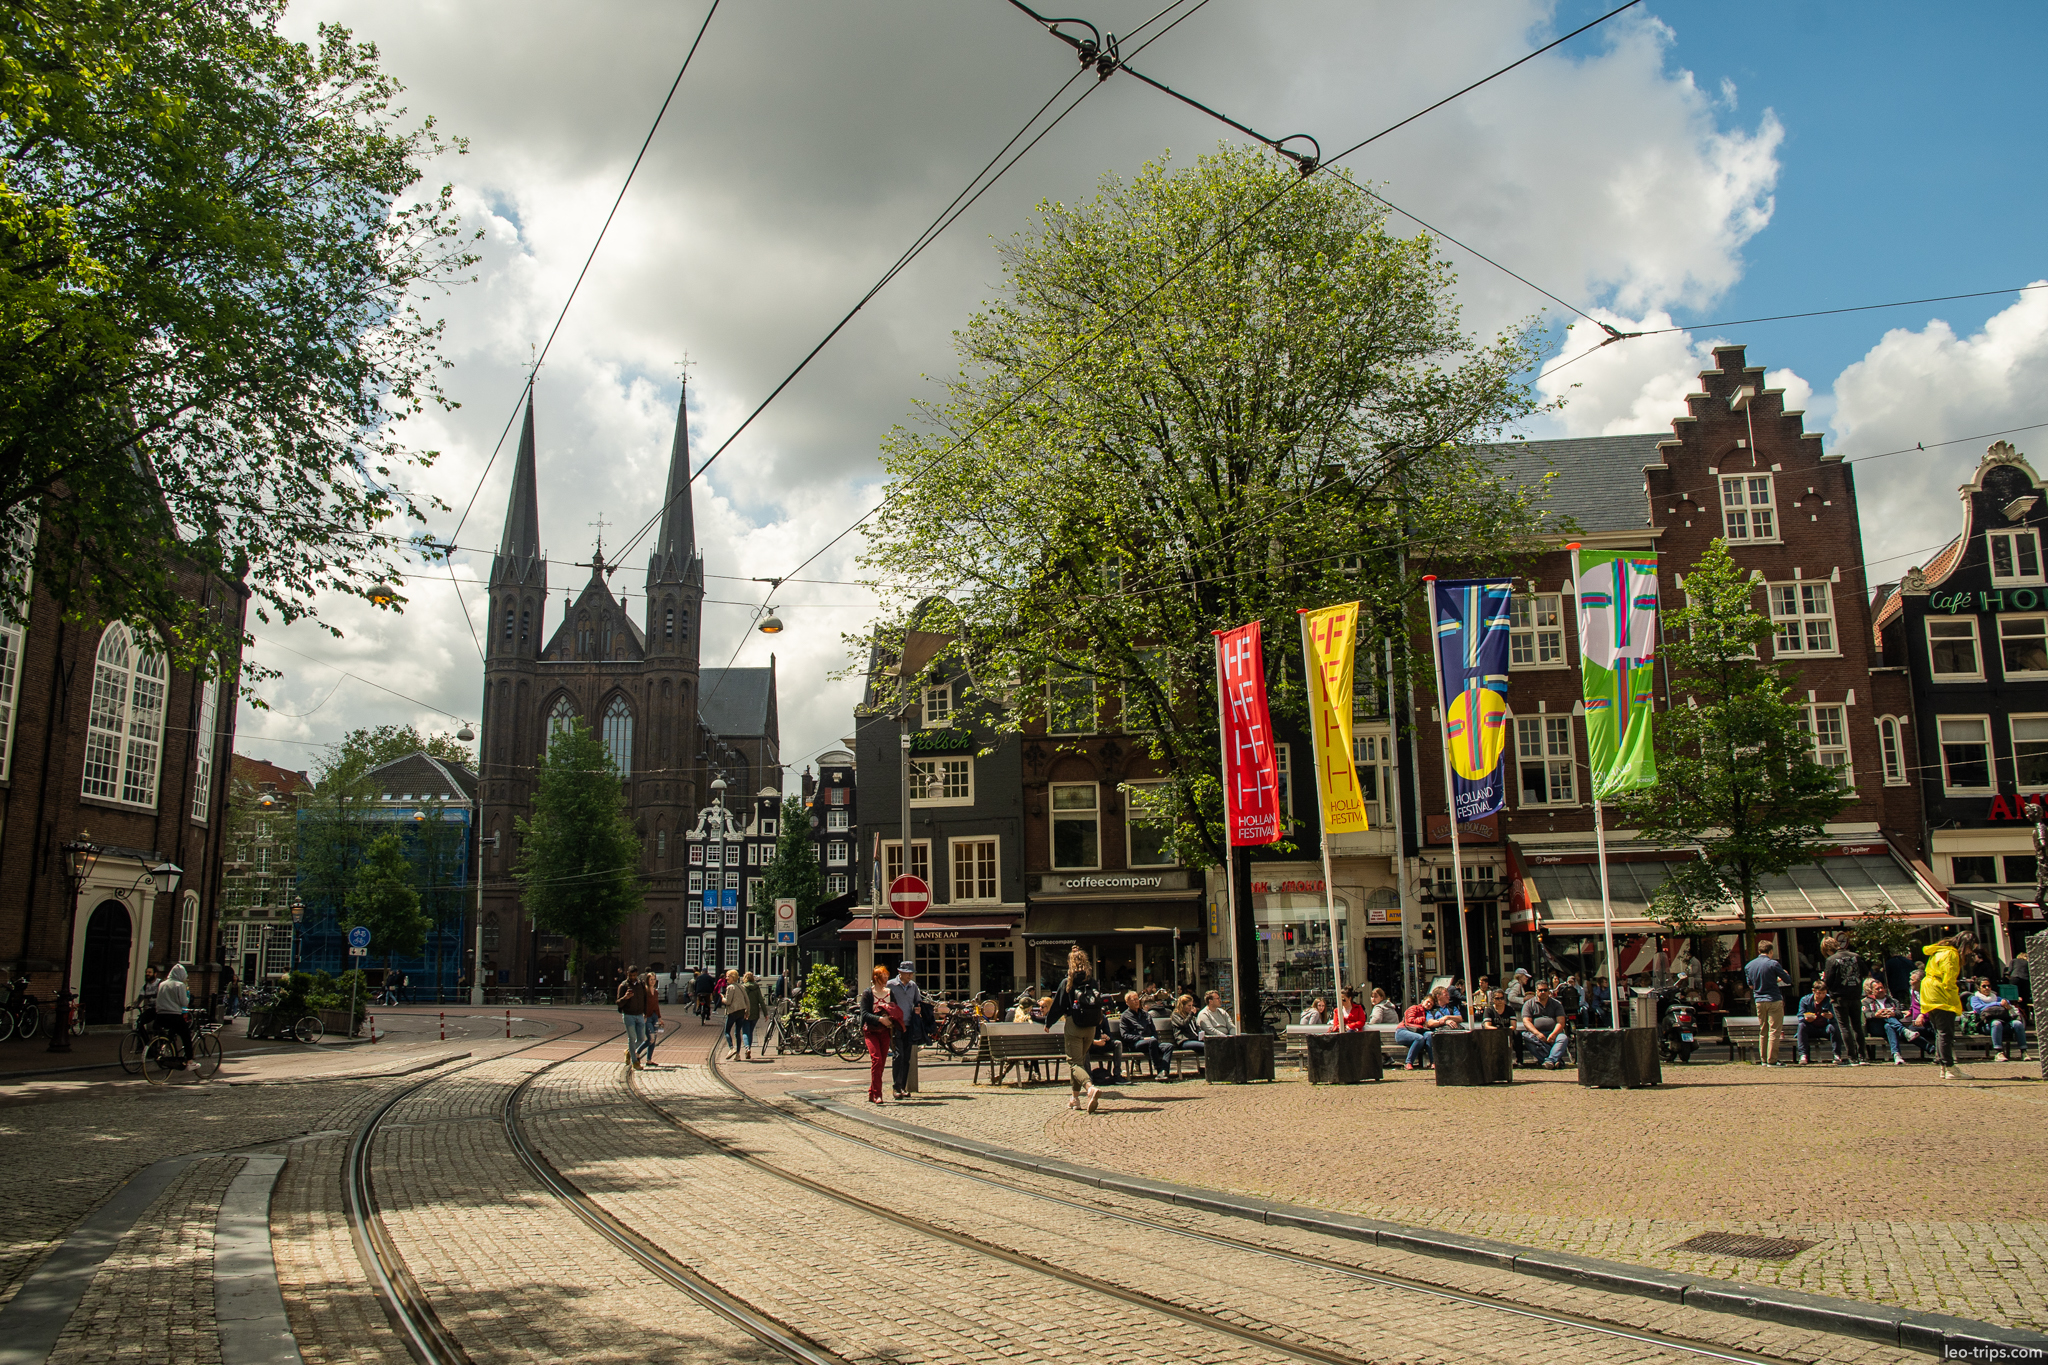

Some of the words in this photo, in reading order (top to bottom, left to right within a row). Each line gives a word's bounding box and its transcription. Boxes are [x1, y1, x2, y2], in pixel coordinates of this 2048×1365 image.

[1930, 590, 1971, 614] Café
[1980, 589, 2048, 611] HO
[1456, 786, 1494, 806] HOLLAND
[1457, 801, 1493, 818] FESTIVAL
[1987, 793, 2048, 820] AM
[1238, 825, 1275, 839] FESTIVAL
[1432, 822, 1494, 839] LUXMBOURG
[1066, 876, 1162, 887] coffeecompany
[1281, 880, 1327, 892] SMOKIN
[1036, 939, 1077, 947] coffeecompany
